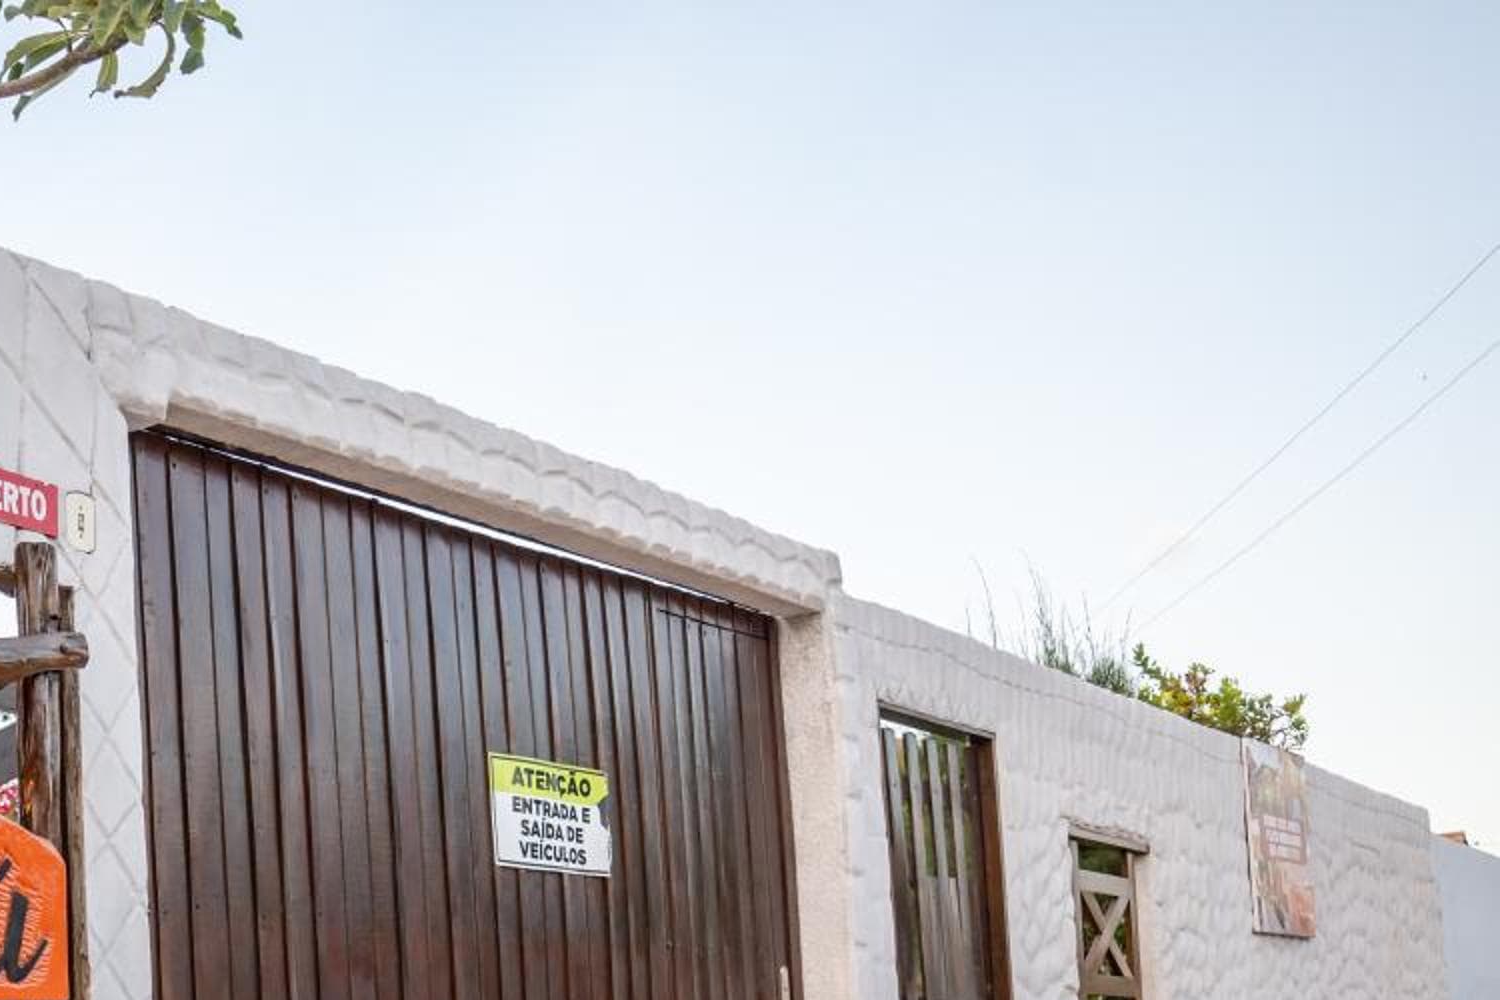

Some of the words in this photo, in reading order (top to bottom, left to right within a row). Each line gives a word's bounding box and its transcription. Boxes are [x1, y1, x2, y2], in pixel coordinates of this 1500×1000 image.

[511, 765, 591, 798] ATENÇÃO
[512, 796, 578, 821] ENTRADA
[581, 807, 591, 824] E
[521, 818, 564, 841] SAÍDA
[567, 826, 584, 844] DE
[519, 838, 587, 865] VEÍCULOS
